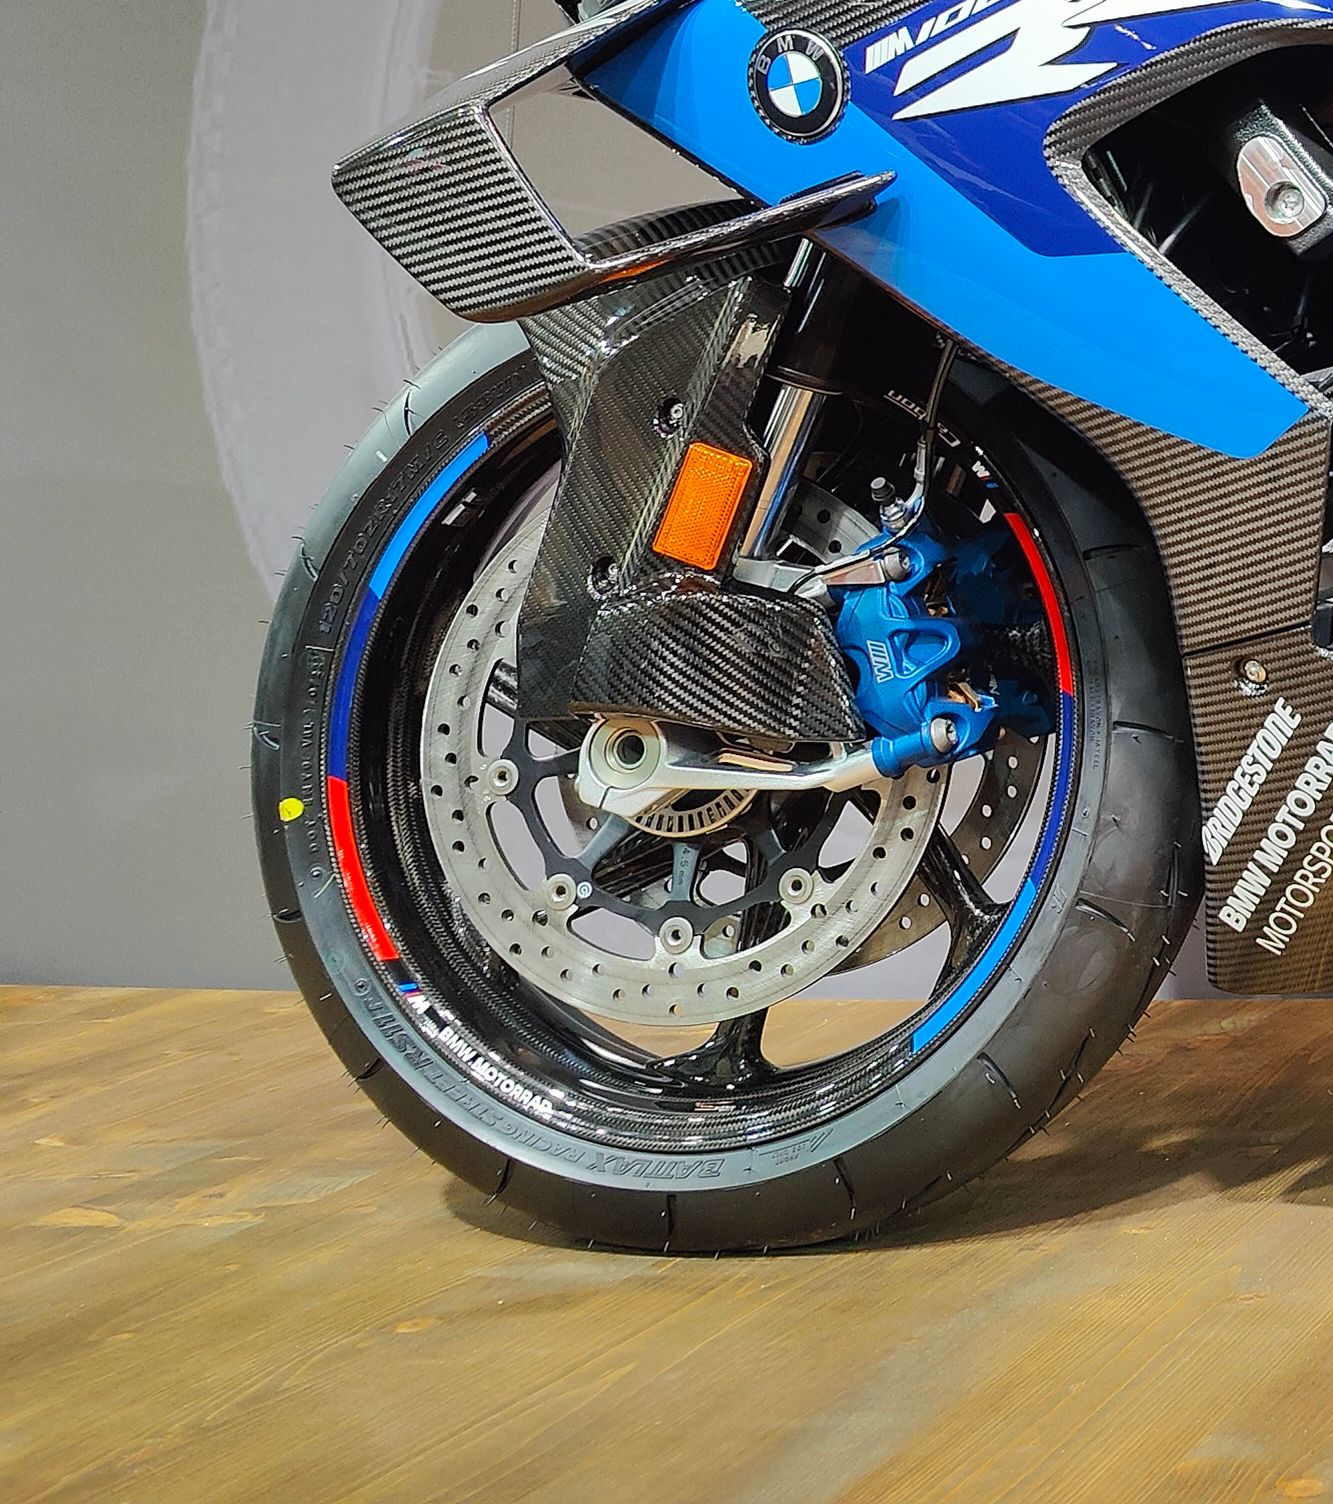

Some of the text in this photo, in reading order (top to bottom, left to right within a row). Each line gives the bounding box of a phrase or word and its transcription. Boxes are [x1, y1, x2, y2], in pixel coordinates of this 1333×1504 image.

[756, 36, 825, 75] BMW
[1201, 697, 1301, 866] BRIDGESTONE
[1218, 862, 1271, 933] BMW
